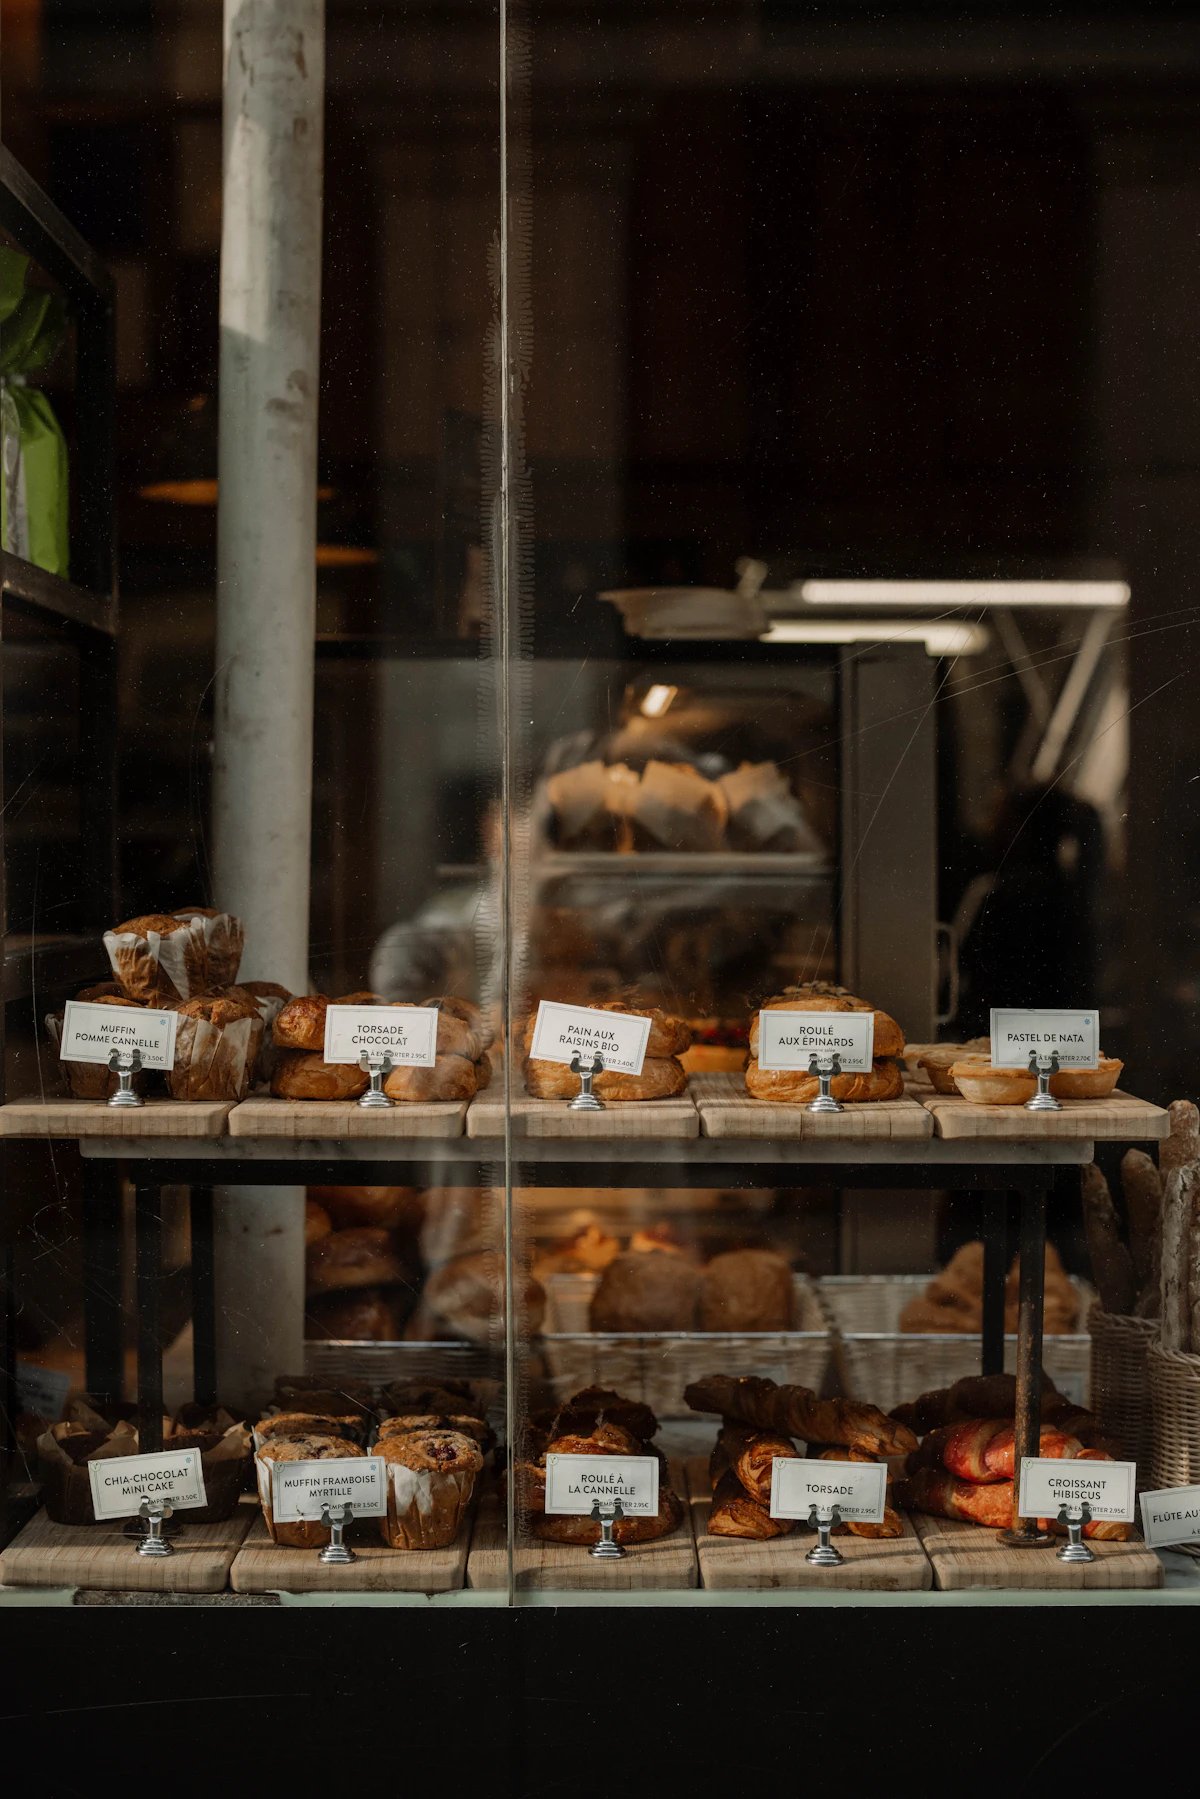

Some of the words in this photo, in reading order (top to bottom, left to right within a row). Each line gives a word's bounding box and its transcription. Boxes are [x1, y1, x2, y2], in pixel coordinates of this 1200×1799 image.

[100, 1025, 136, 1035] MUFFIN
[357, 1025, 404, 1035] TORSADE
[567, 1025, 592, 1037] PAIN
[594, 1030, 616, 1041] AUX
[799, 1025, 834, 1035] ROULÉ
[75, 1033, 109, 1043] POMME
[112, 1036, 160, 1048] CANNELLE
[351, 1035, 408, 1046] CHOCOLAT
[559, 1035, 599, 1049] RAISINS
[601, 1041, 620, 1052] BIO
[778, 1037, 800, 1045] AUX
[802, 1035, 854, 1047] ÉPINARDS
[1007, 1033, 1041, 1042] PASTEL
[1043, 1033, 1057, 1042] DE
[1059, 1034, 1084, 1043] NATA
[617, 1059, 635, 1068] 2.40€
[104, 1468, 189, 1486] CHIA-CHOCOLAT
[284, 1478, 320, 1488] MUFFIN
[323, 1475, 376, 1485] FRAMBOISE
[581, 1473, 615, 1484] ROULÉ
[616, 1473, 624, 1484] À
[122, 1484, 145, 1495] MINI
[147, 1481, 175, 1492] CAKE
[1048, 1478, 1107, 1489] CROISSANT
[309, 1487, 352, 1497] MYRTILLE
[568, 1485, 581, 1494] LA
[583, 1485, 636, 1495] CANNELLE
[806, 1484, 854, 1495] TORSADE
[1053, 1490, 1101, 1500] HIBISCUS
[1153, 1511, 1183, 1523] FLÛTE
[1184, 1509, 1200, 1519] AU
